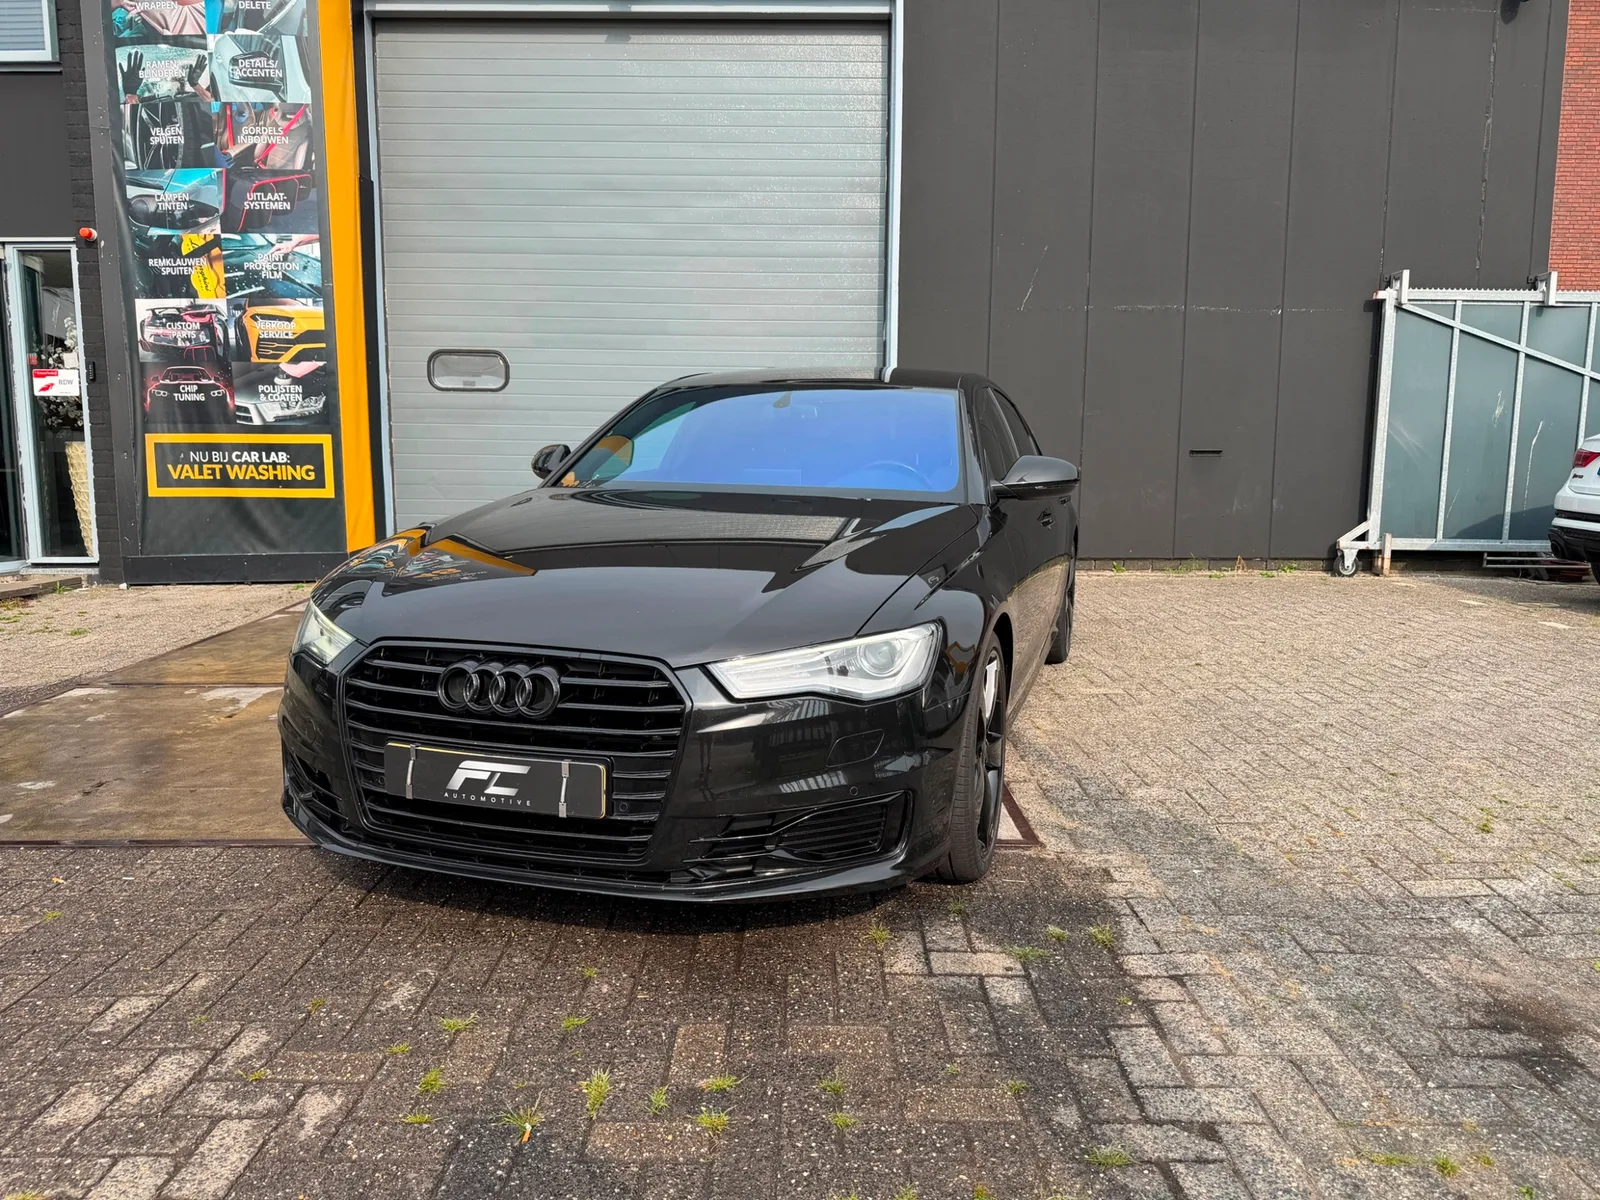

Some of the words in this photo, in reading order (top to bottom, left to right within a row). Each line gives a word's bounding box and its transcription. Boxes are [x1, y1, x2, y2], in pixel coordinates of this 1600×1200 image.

[135, 0, 179, 10] WRAPPEN
[238, 1, 272, 10] DELETE
[146, 60, 178, 69] RAMEN
[238, 59, 279, 69] DETAILS/
[138, 69, 186, 78] BLINDEREN
[235, 68, 283, 78] ACCENTEN
[150, 127, 183, 136] VELGEN
[242, 126, 284, 135] GORDELS
[149, 135, 185, 145] SPUITEN
[237, 135, 289, 145] INBOUWEN
[154, 193, 189, 202] LAMPEN
[246, 192, 287, 201] UITLAAT-
[158, 201, 188, 210] TINTEN
[243, 201, 291, 210] SYSTEMEN
[257, 253, 284, 262] PAINT
[148, 258, 207, 267] REMKLAUWEN
[244, 261, 300, 271] PROTECTION
[161, 266, 195, 276] SPUITEN
[261, 270, 283, 280] FILM
[165, 321, 200, 330] CUSTOM
[256, 320, 297, 330] VERKOOP
[171, 330, 197, 339] PARTS
[259, 329, 295, 339] SERVICE
[179, 384, 199, 393] CHIP
[258, 384, 303, 395] POLIJSTEN
[173, 393, 206, 401] TUNING
[259, 393, 267, 401] &
[267, 393, 303, 402] COATEN
[190, 451, 209, 463] NU
[212, 451, 229, 463] BIJ
[231, 451, 261, 463] CAR
[262, 451, 291, 463] LAB:
[167, 463, 223, 480] VALET
[226, 464, 316, 481] WASHING
[444, 791, 531, 806] AUTOMOTIVE
